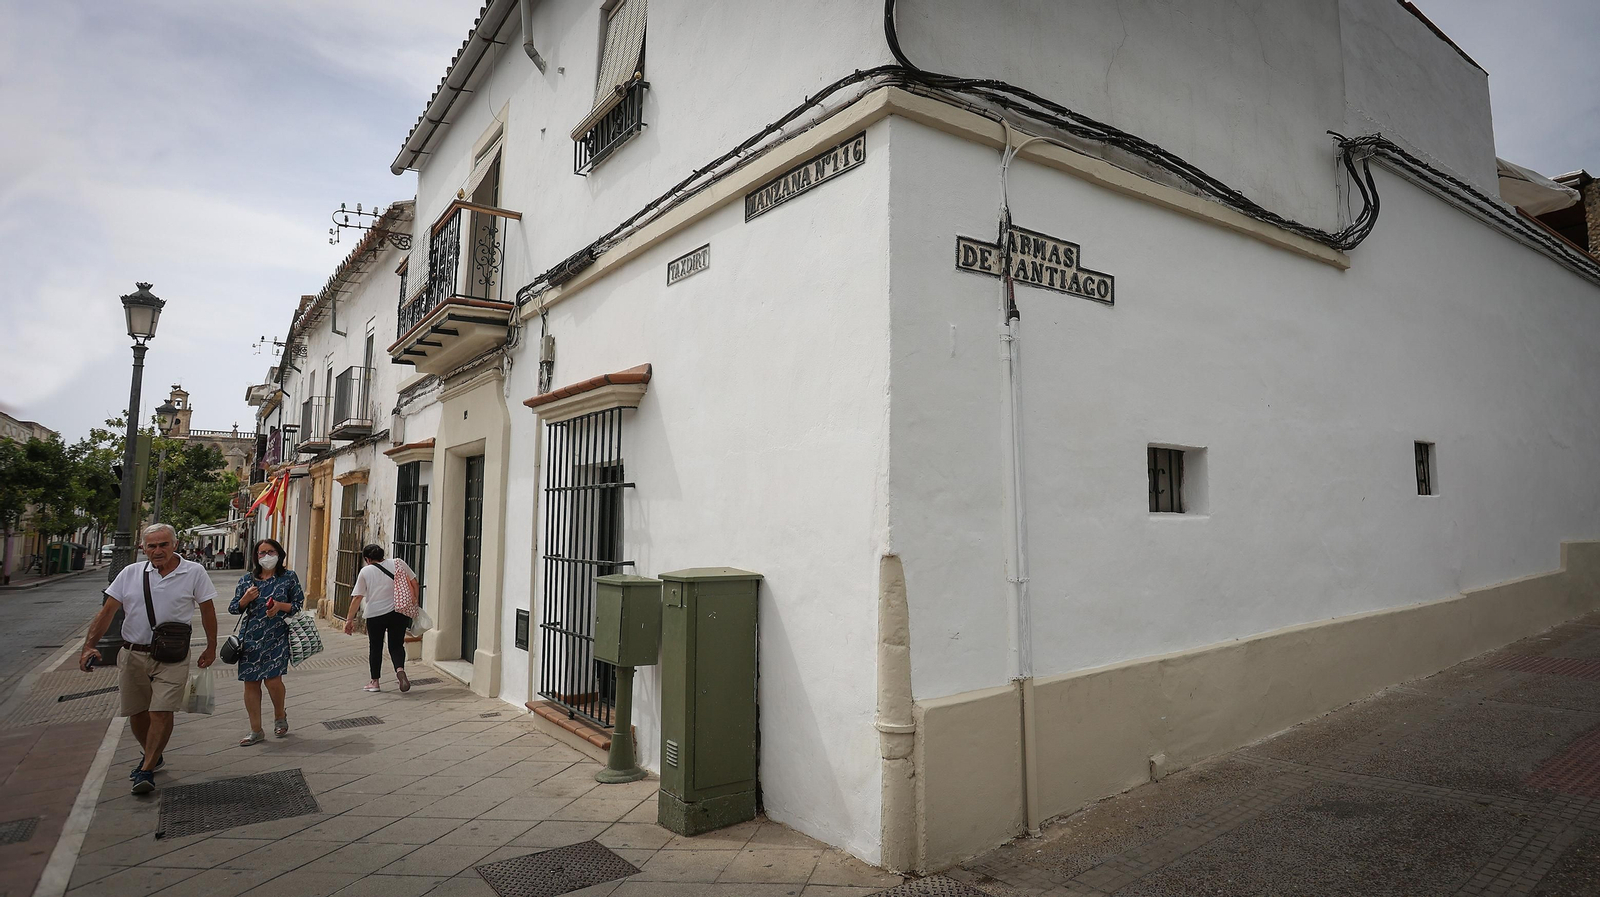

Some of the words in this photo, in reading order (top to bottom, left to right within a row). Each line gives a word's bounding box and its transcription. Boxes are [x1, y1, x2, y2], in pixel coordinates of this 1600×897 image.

[746, 166, 811, 217] MANZANA
[670, 249, 707, 280] TAXDIRT
[961, 243, 992, 271] DE
[1009, 258, 1110, 299] ANTIAGO
[1008, 231, 1075, 268] ARMAS
